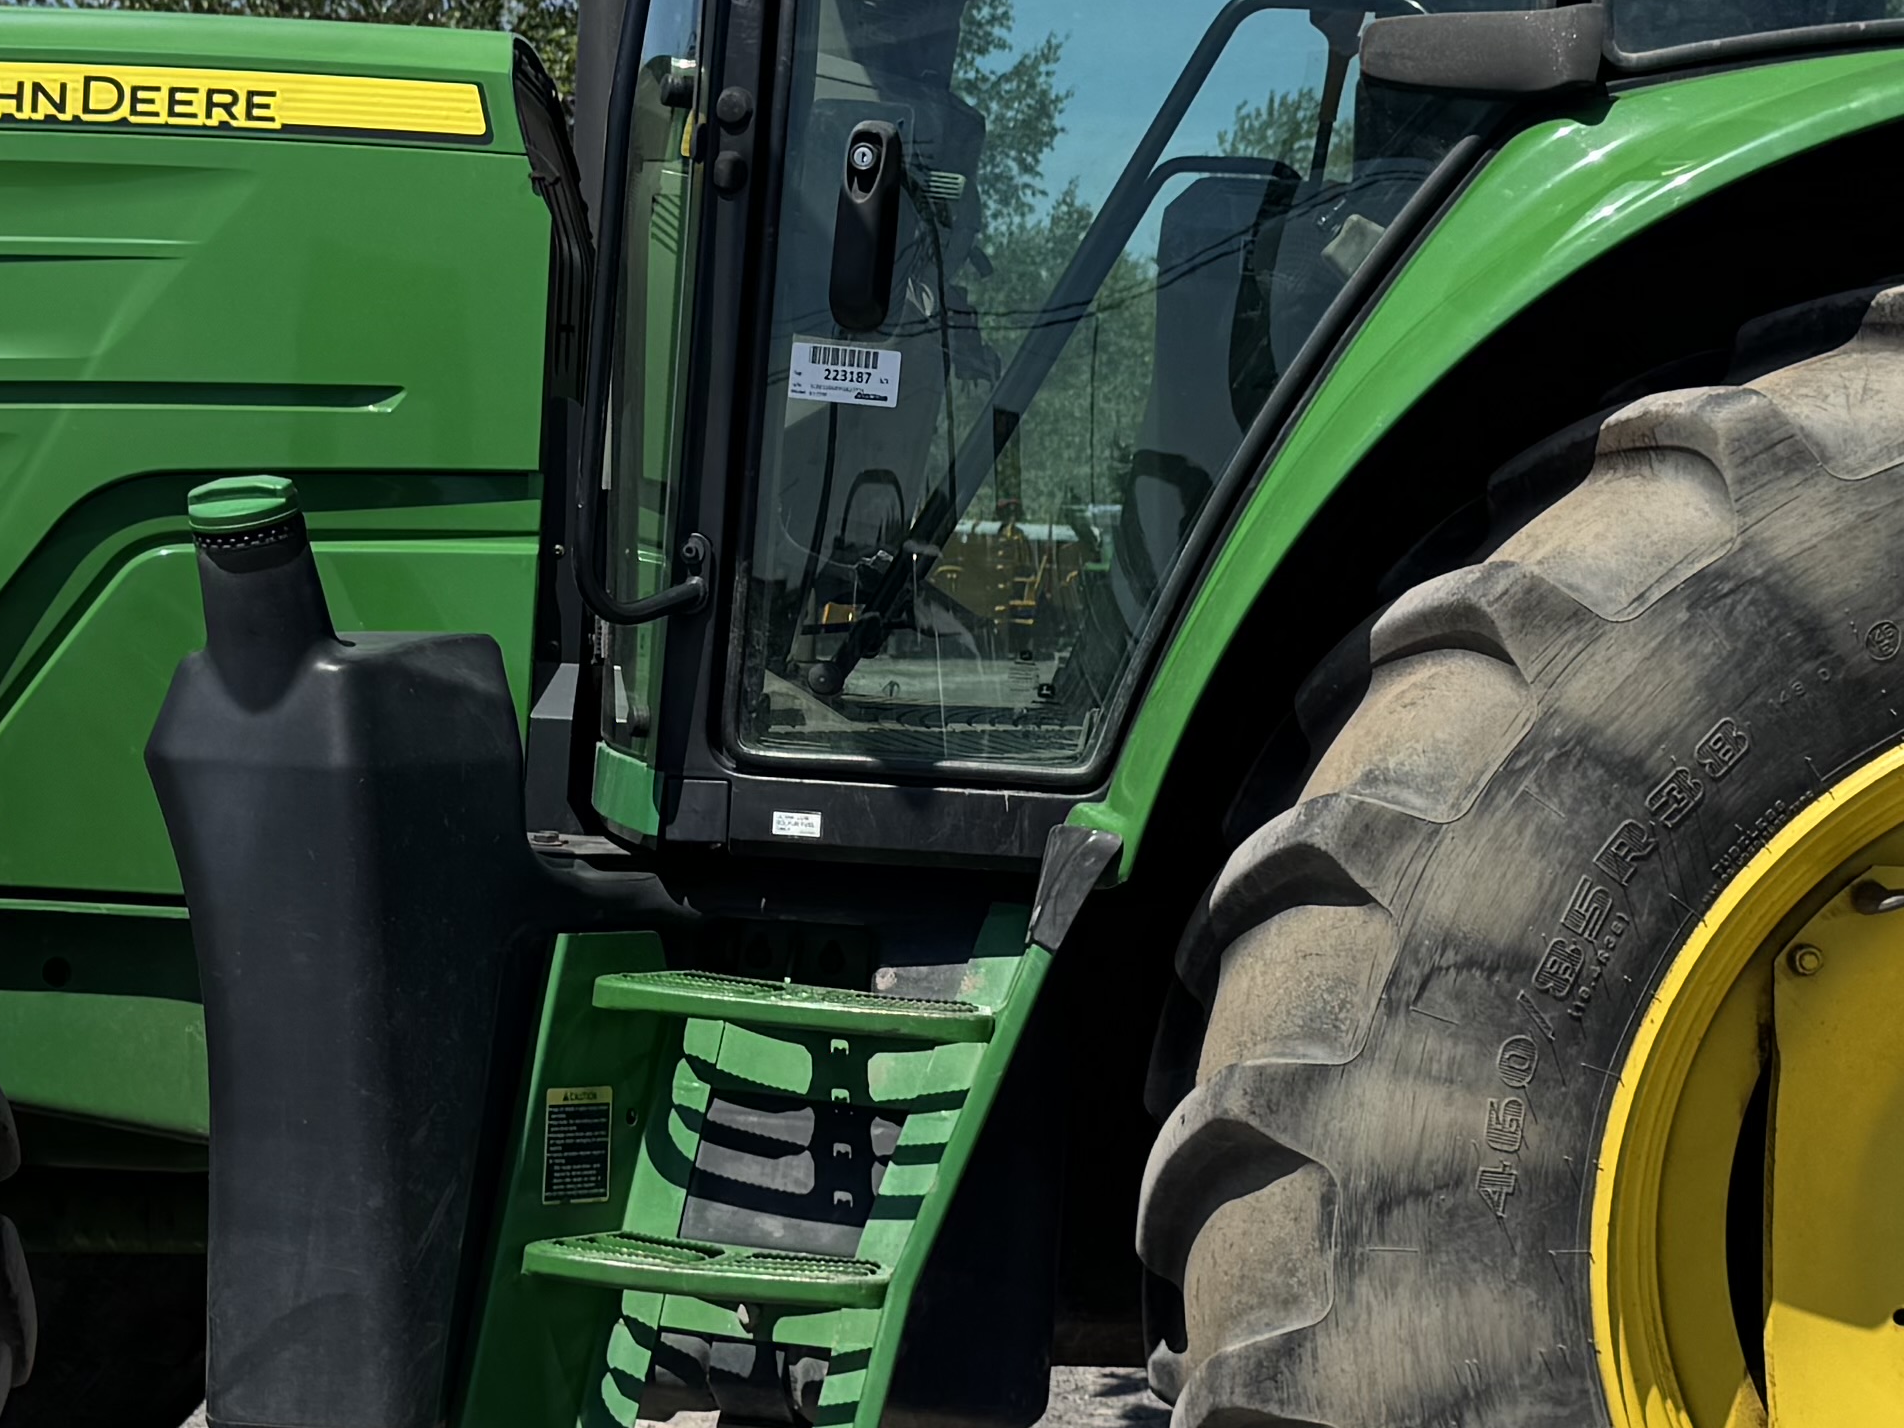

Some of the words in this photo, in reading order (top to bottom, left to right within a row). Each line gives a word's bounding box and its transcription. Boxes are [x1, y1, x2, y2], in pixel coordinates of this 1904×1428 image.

[82, 75, 278, 123] DEERE
[823, 368, 872, 385] 223187
[1475, 717, 1749, 1218] 460/85R38
